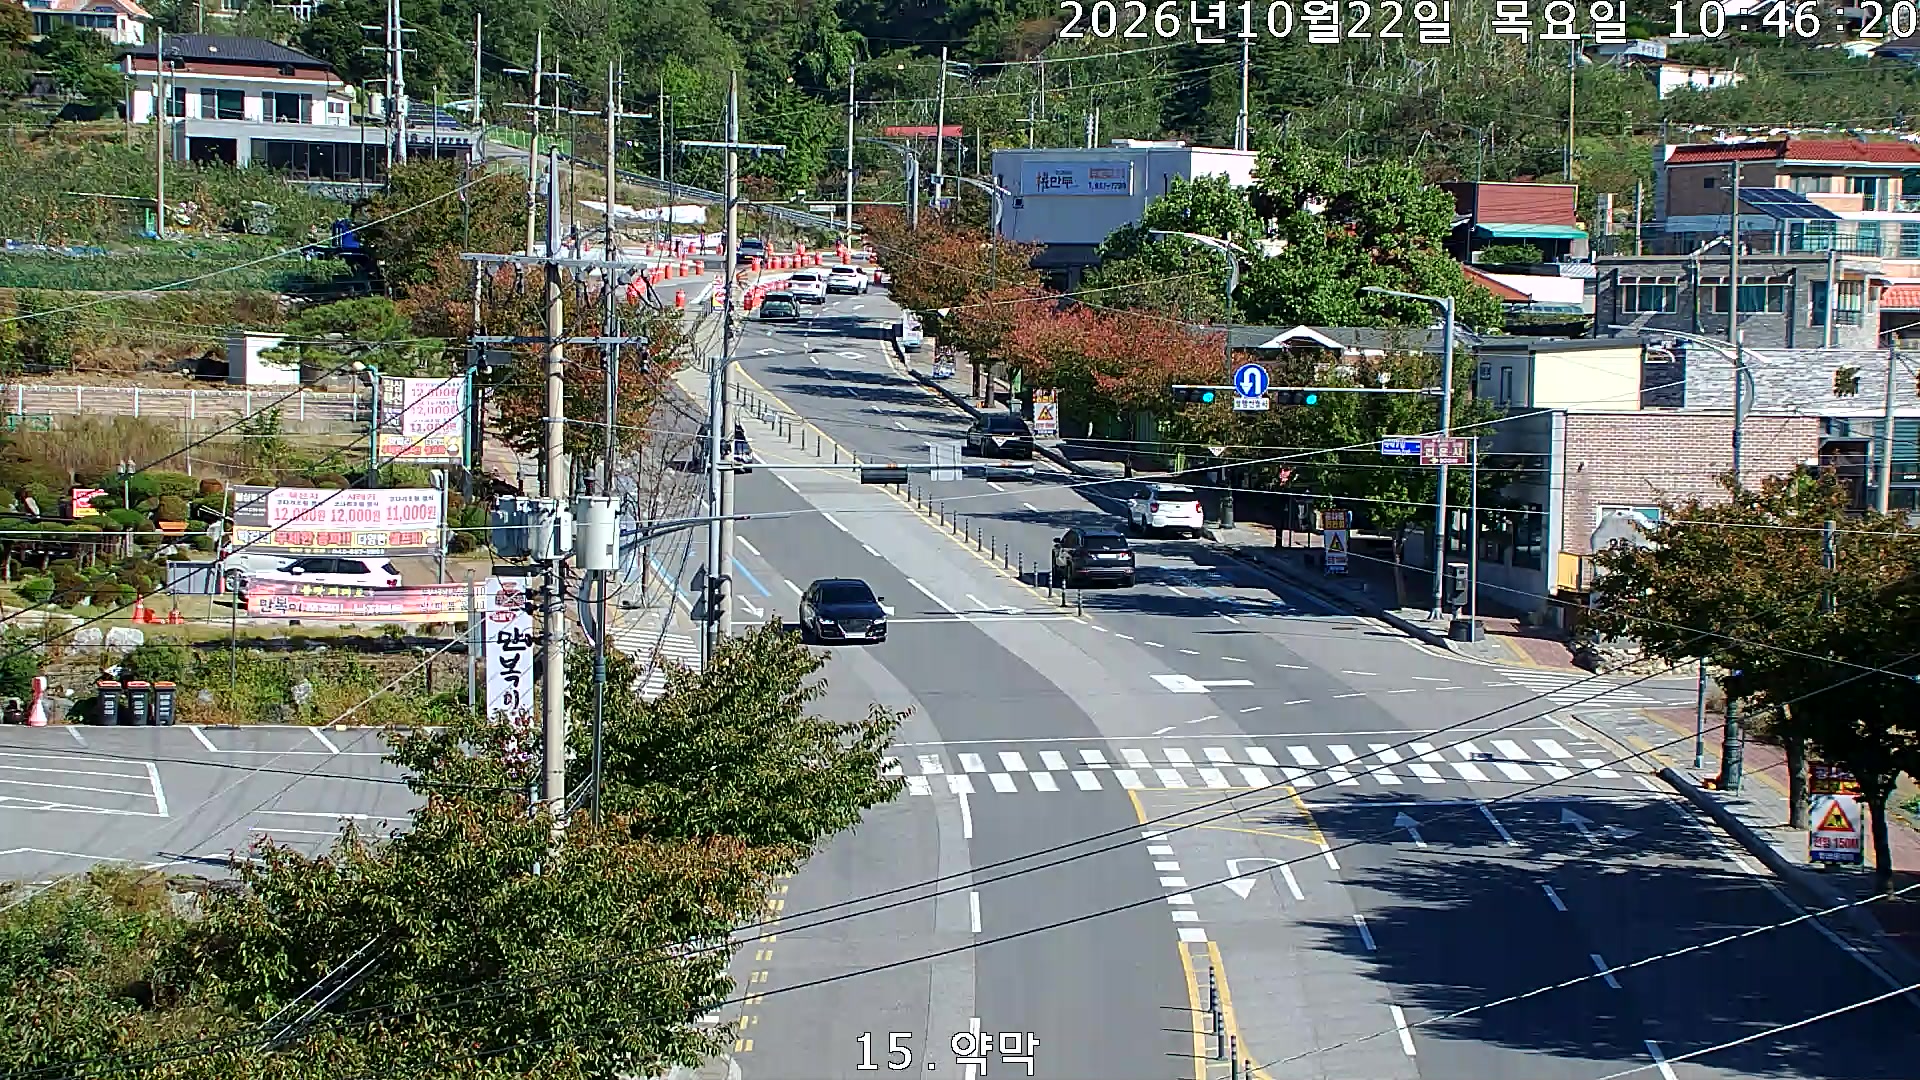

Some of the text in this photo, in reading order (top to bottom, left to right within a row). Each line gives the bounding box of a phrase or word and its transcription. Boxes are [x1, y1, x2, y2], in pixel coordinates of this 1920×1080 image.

[331, 508, 381, 524] 12,000원
[386, 504, 437, 521] 11,000원
[496, 626, 531, 710] 만복이
